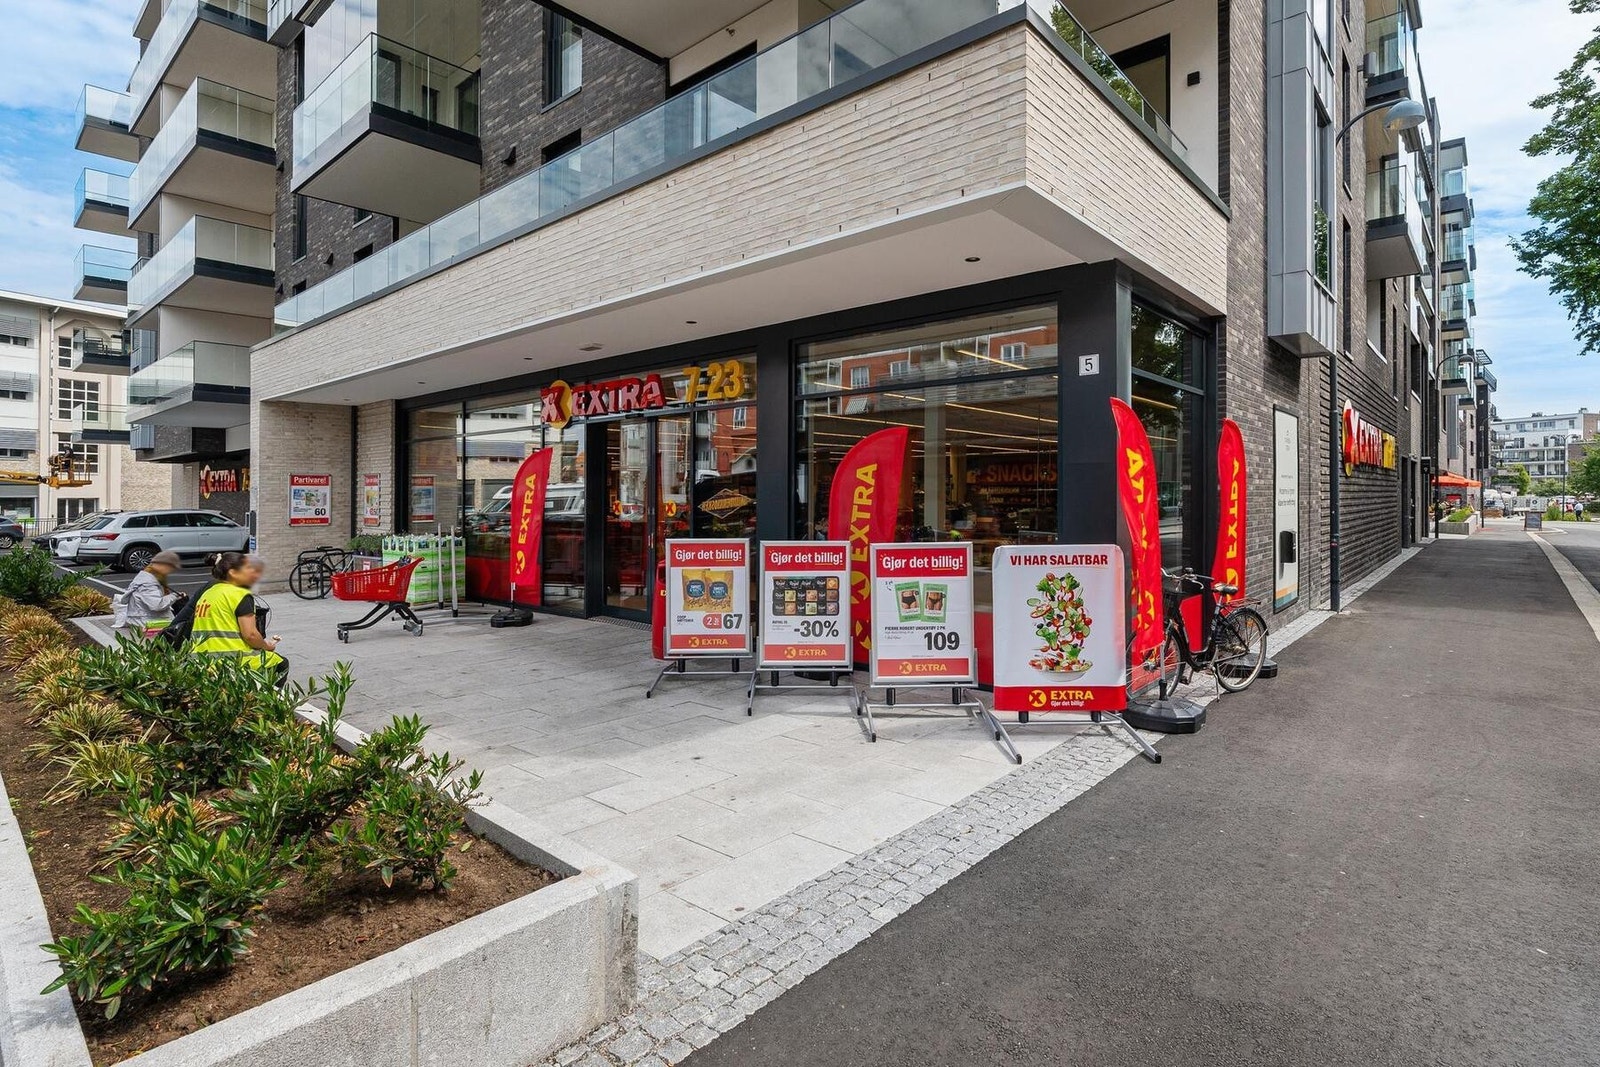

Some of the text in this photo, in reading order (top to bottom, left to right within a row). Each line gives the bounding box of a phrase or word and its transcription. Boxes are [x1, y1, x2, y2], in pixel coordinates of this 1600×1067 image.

[1085, 358, 1093, 371] 5
[571, 374, 667, 417] EXTRA
[682, 360, 746, 404] 7-23
[314, 508, 327, 516] 60
[518, 473, 537, 545] EXTRA
[850, 463, 877, 562] EXTRA
[675, 550, 742, 562] Gjør det billig!
[771, 552, 843, 565] Gjør det billig!
[1010, 554, 1109, 566] VI HAR SALATBAR
[882, 556, 963, 570] Gjør det billig!
[723, 614, 743, 629] 67
[793, 620, 840, 638] -30%
[923, 631, 960, 651] 109
[915, 663, 947, 671] EXTRA
[1050, 690, 1094, 700] EXTRA
